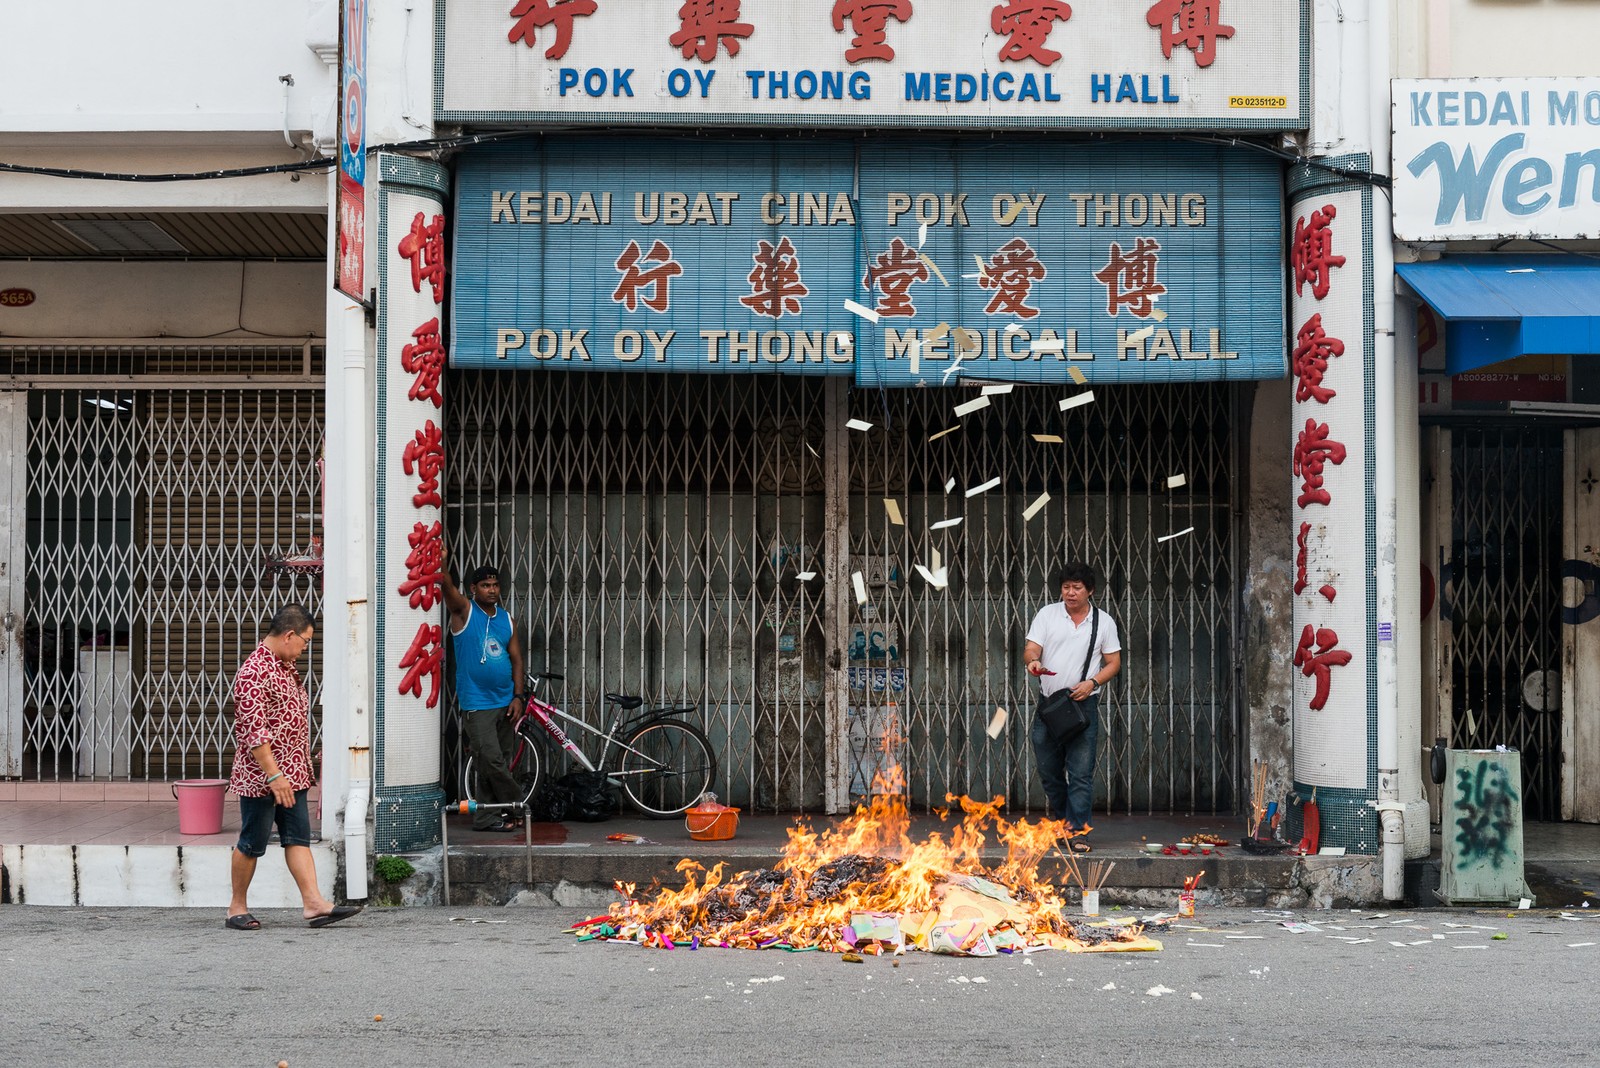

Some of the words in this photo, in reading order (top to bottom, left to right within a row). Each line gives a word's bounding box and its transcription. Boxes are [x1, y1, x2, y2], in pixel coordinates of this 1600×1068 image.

[559, 68, 635, 98] POK
[667, 69, 717, 99] OY
[746, 70, 871, 100] THONG
[904, 71, 1061, 102] MEDICAL
[1090, 73, 1179, 103] HALL
[1230, 97, 1244, 106] PG
[1245, 98, 1286, 107] 0235112-D
[1410, 90, 1529, 126] KEDAI
[491, 191, 612, 225] KEDAI
[634, 191, 740, 226] UBAT
[760, 191, 856, 227] CINA
[887, 192, 971, 228] POK
[991, 192, 1047, 228] OY
[1069, 193, 1207, 228] THONG
[496, 328, 592, 361] POK
[613, 329, 677, 362] OY
[699, 330, 856, 364] THONG
[884, 328, 1096, 363] MEDICAL
[1115, 328, 1240, 363] HALL
